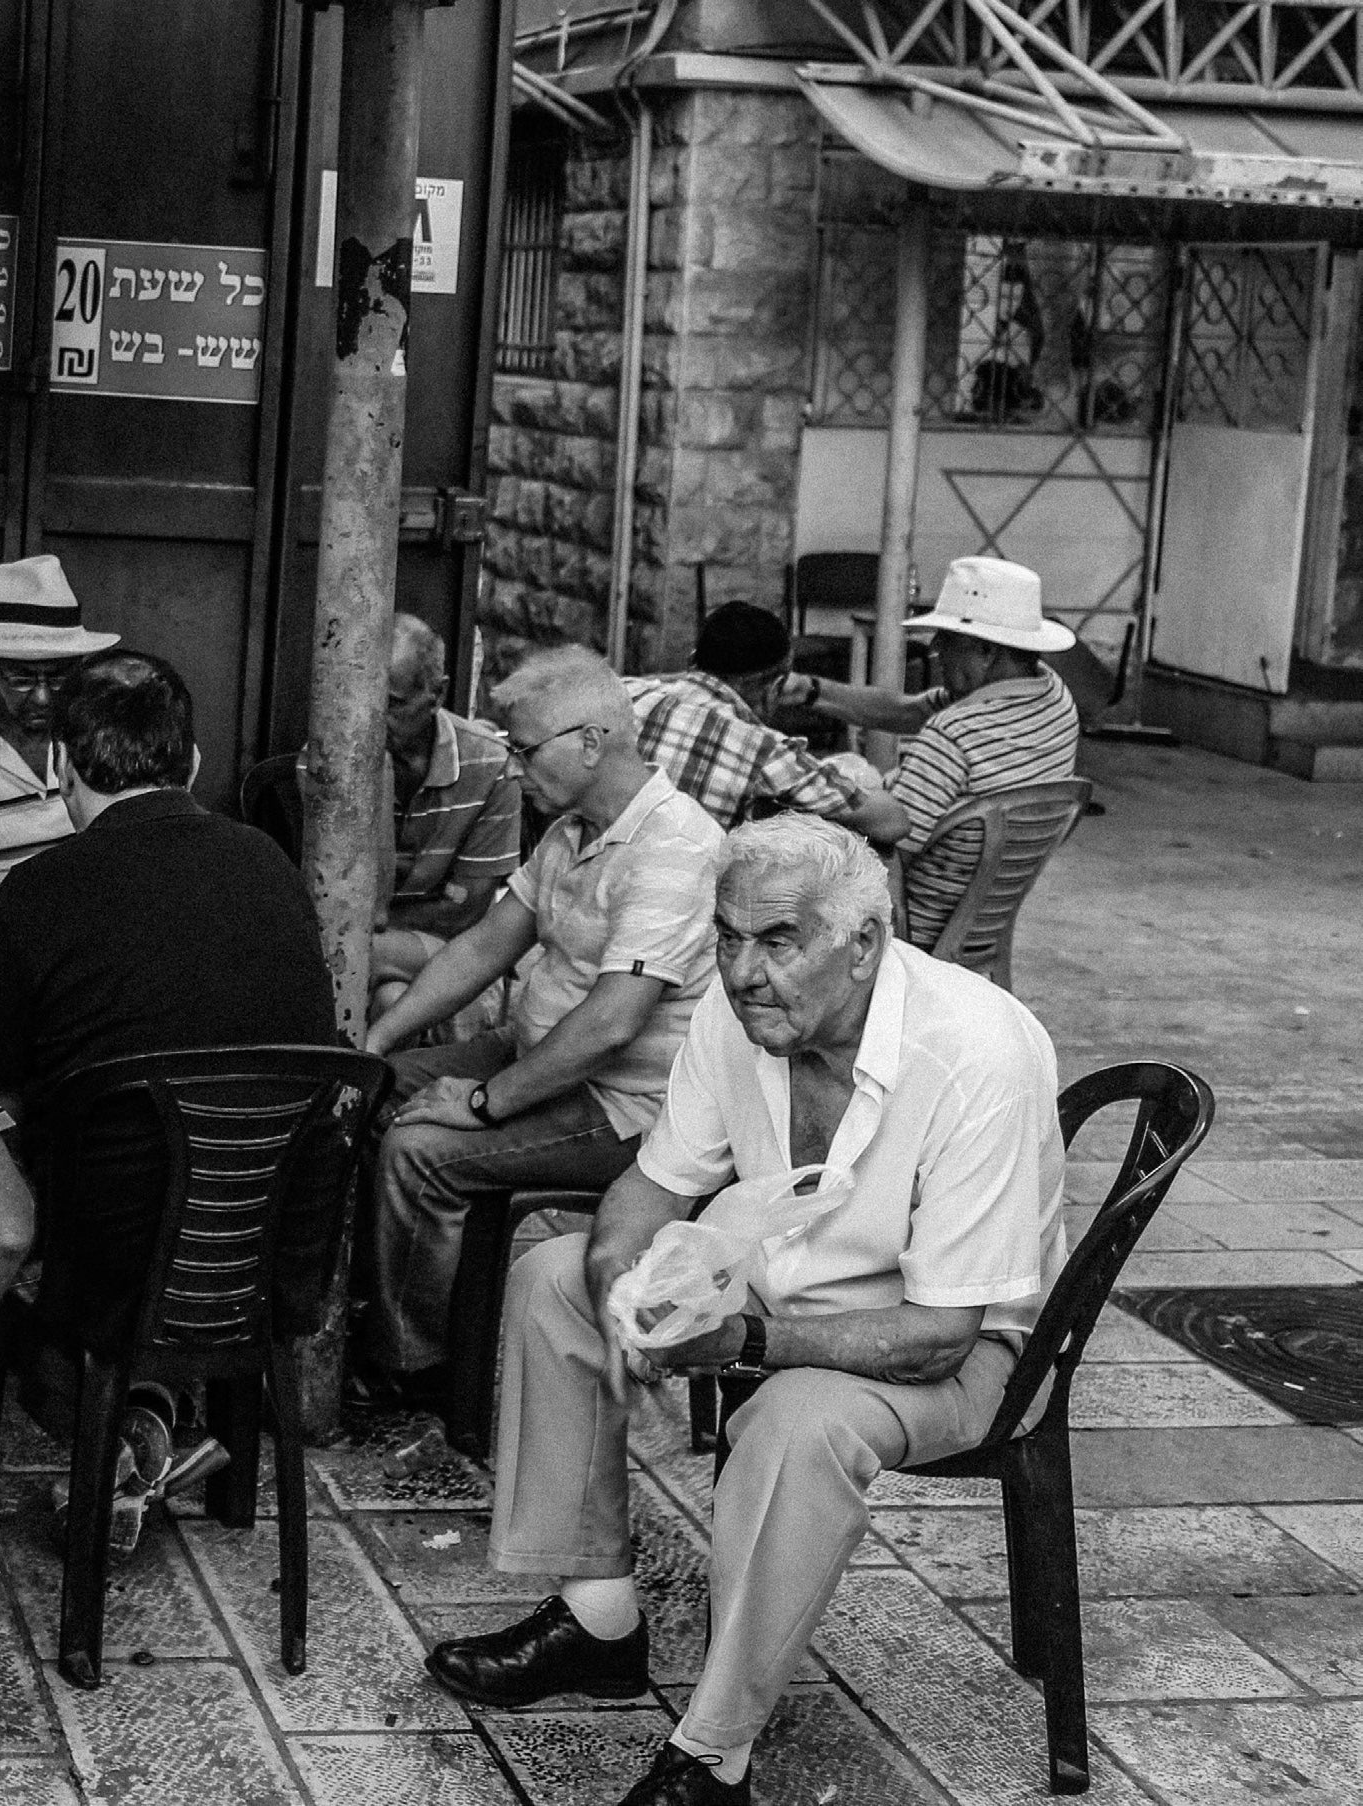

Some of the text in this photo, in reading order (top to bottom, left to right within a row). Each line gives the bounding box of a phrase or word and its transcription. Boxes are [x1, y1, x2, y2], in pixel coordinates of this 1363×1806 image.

[55, 258, 101, 324] 20
[109, 261, 265, 306] כל שעת
[109, 329, 165, 364] בש
